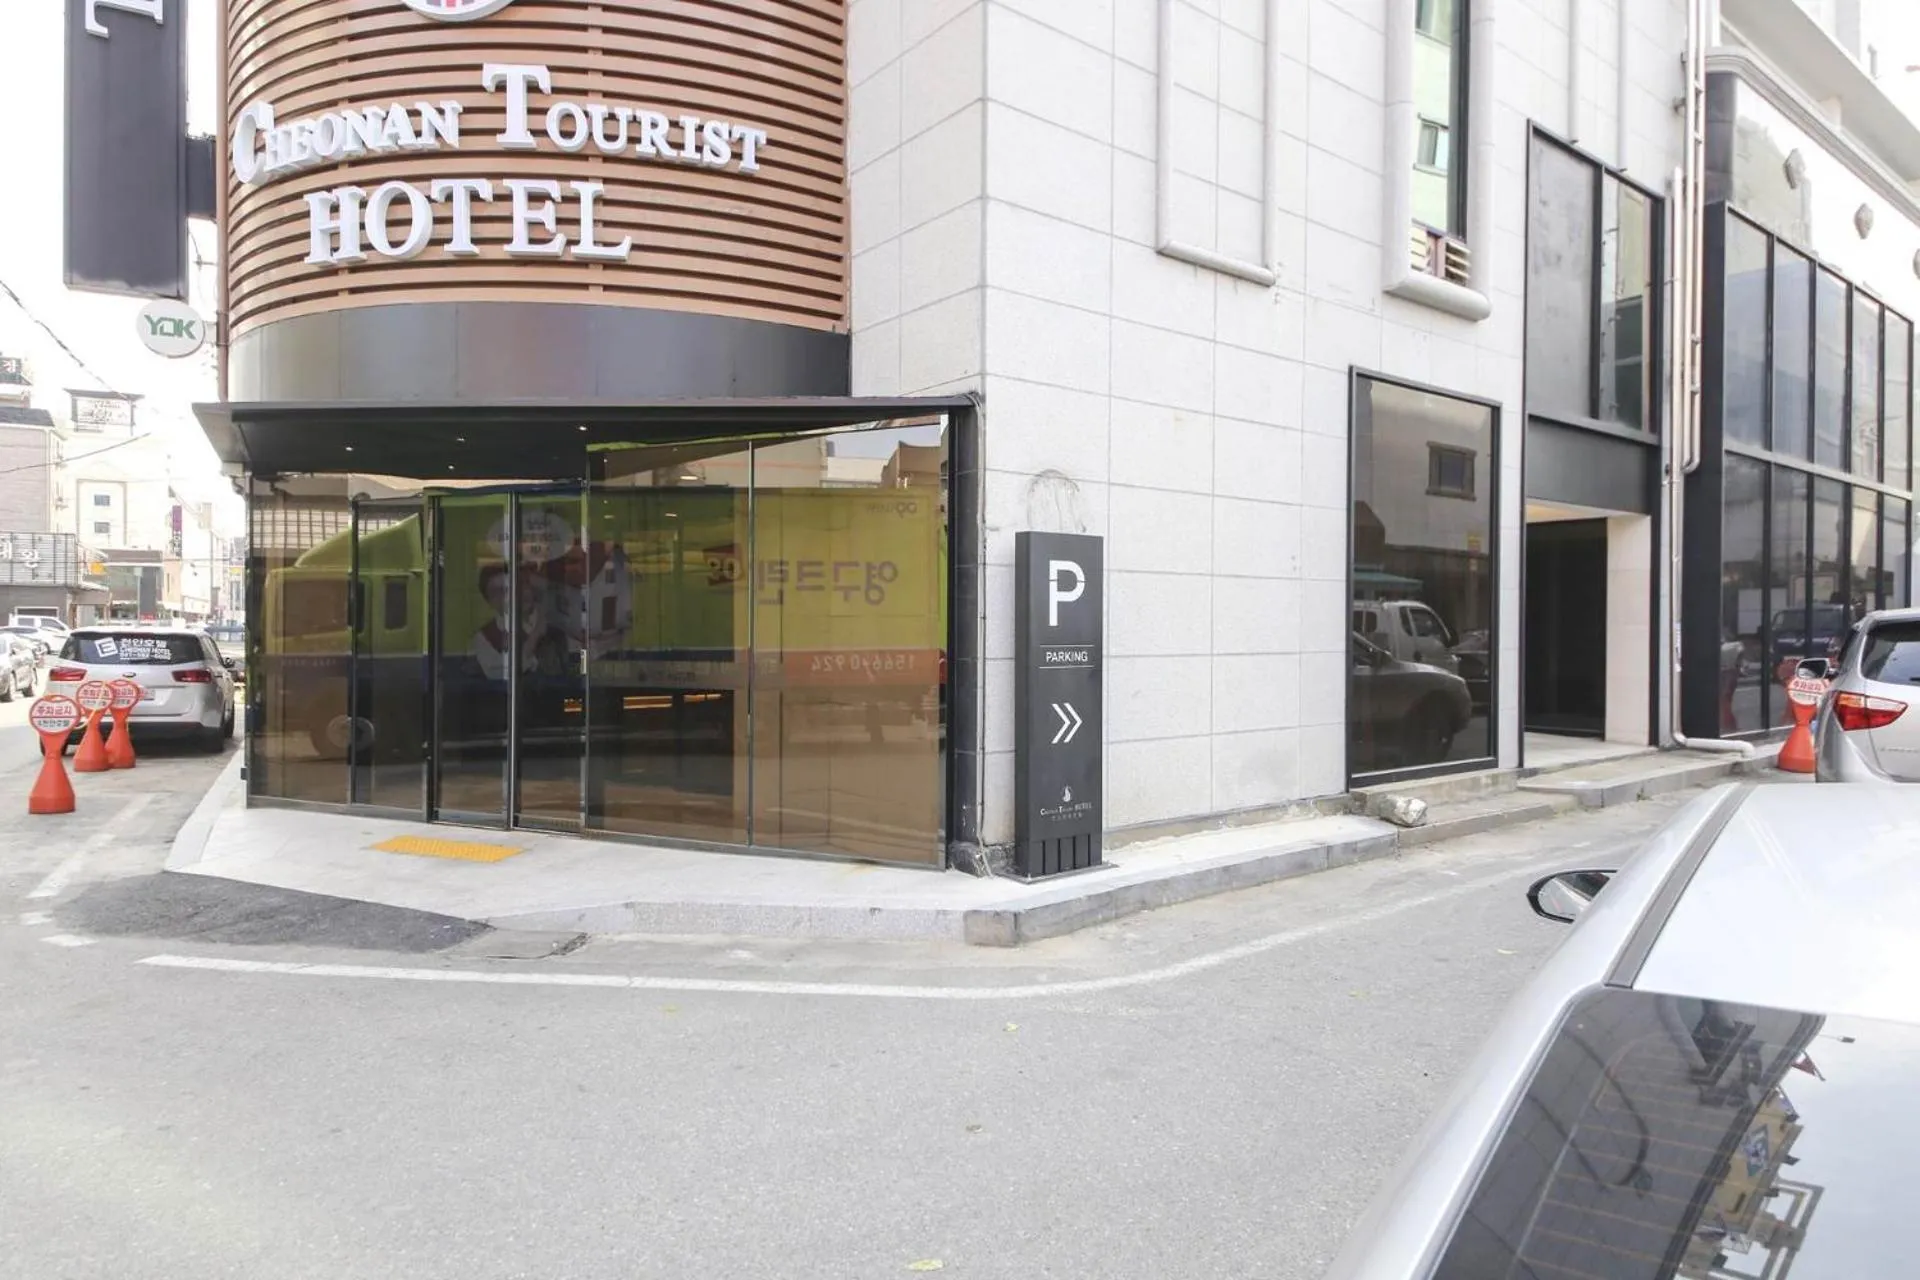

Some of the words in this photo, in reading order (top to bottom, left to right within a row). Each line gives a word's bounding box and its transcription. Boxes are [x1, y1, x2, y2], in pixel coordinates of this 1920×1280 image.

[482, 63, 767, 175] TOURIST
[303, 178, 632, 264] HOTEL
[1049, 560, 1085, 626] P
[1046, 651, 1088, 662] PARKING
[37, 705, 72, 716] 주차금지
